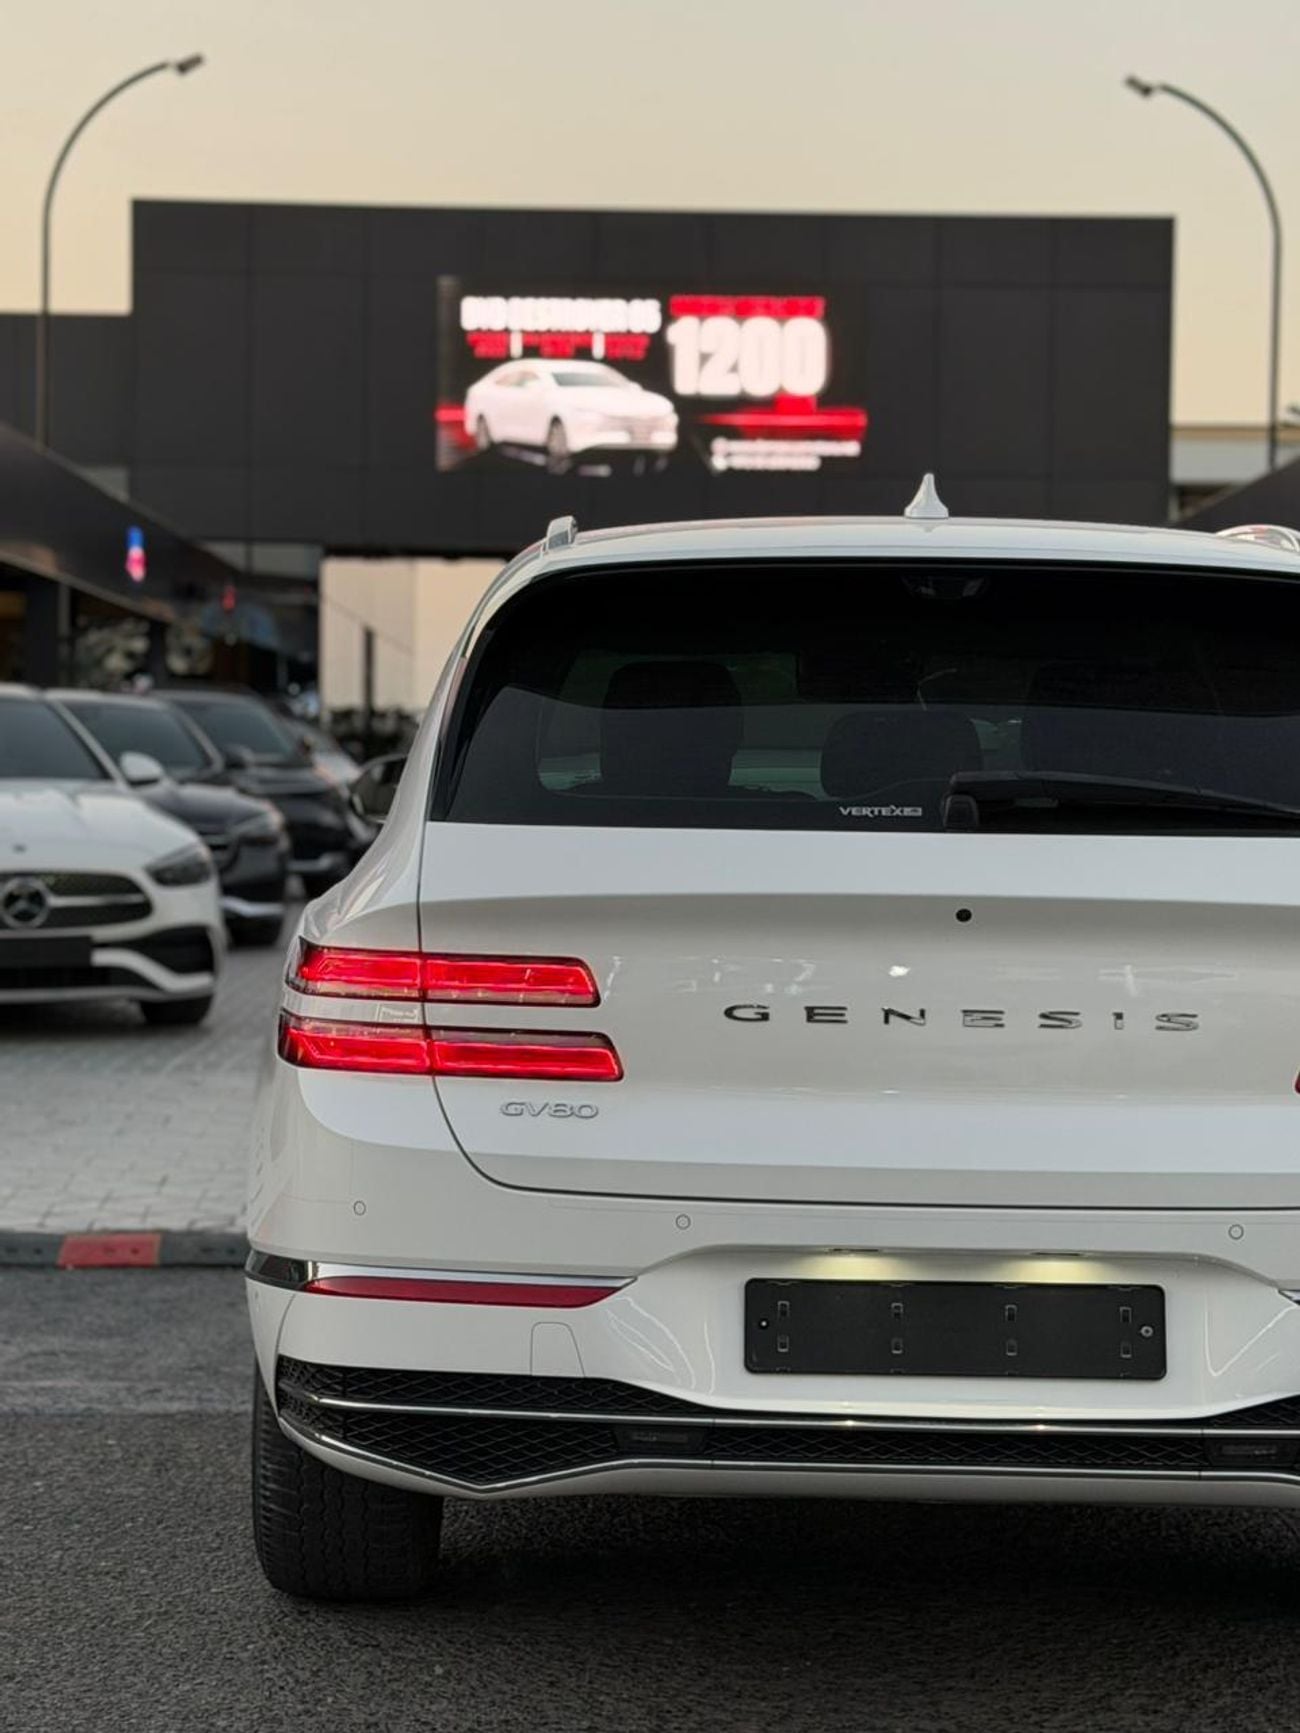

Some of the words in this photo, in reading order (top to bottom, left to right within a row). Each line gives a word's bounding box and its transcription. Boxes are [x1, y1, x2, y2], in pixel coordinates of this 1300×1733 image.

[667, 316, 828, 397] 1200
[723, 1004, 1200, 1032] GENESIS
[500, 1101, 599, 1119] GV80
